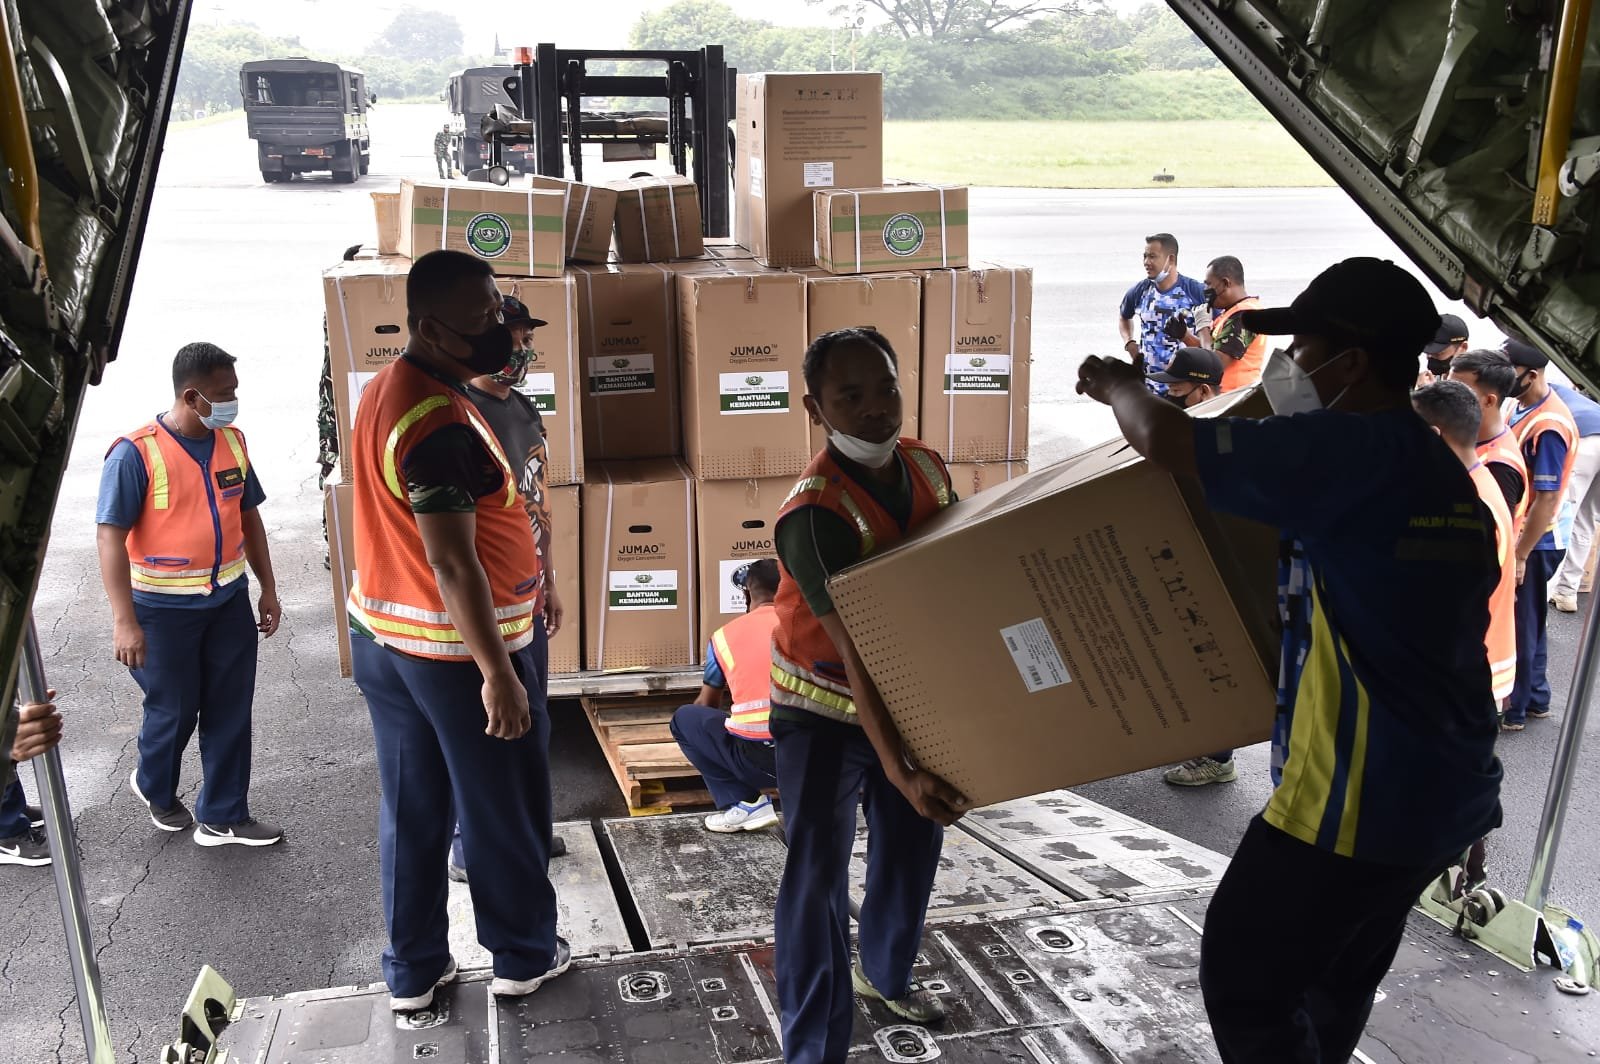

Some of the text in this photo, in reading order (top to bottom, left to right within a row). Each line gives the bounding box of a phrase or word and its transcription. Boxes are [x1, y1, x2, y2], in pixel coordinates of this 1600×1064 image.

[1088, 571, 1101, 585] and
[1102, 524, 1162, 635] Please handle with care!
